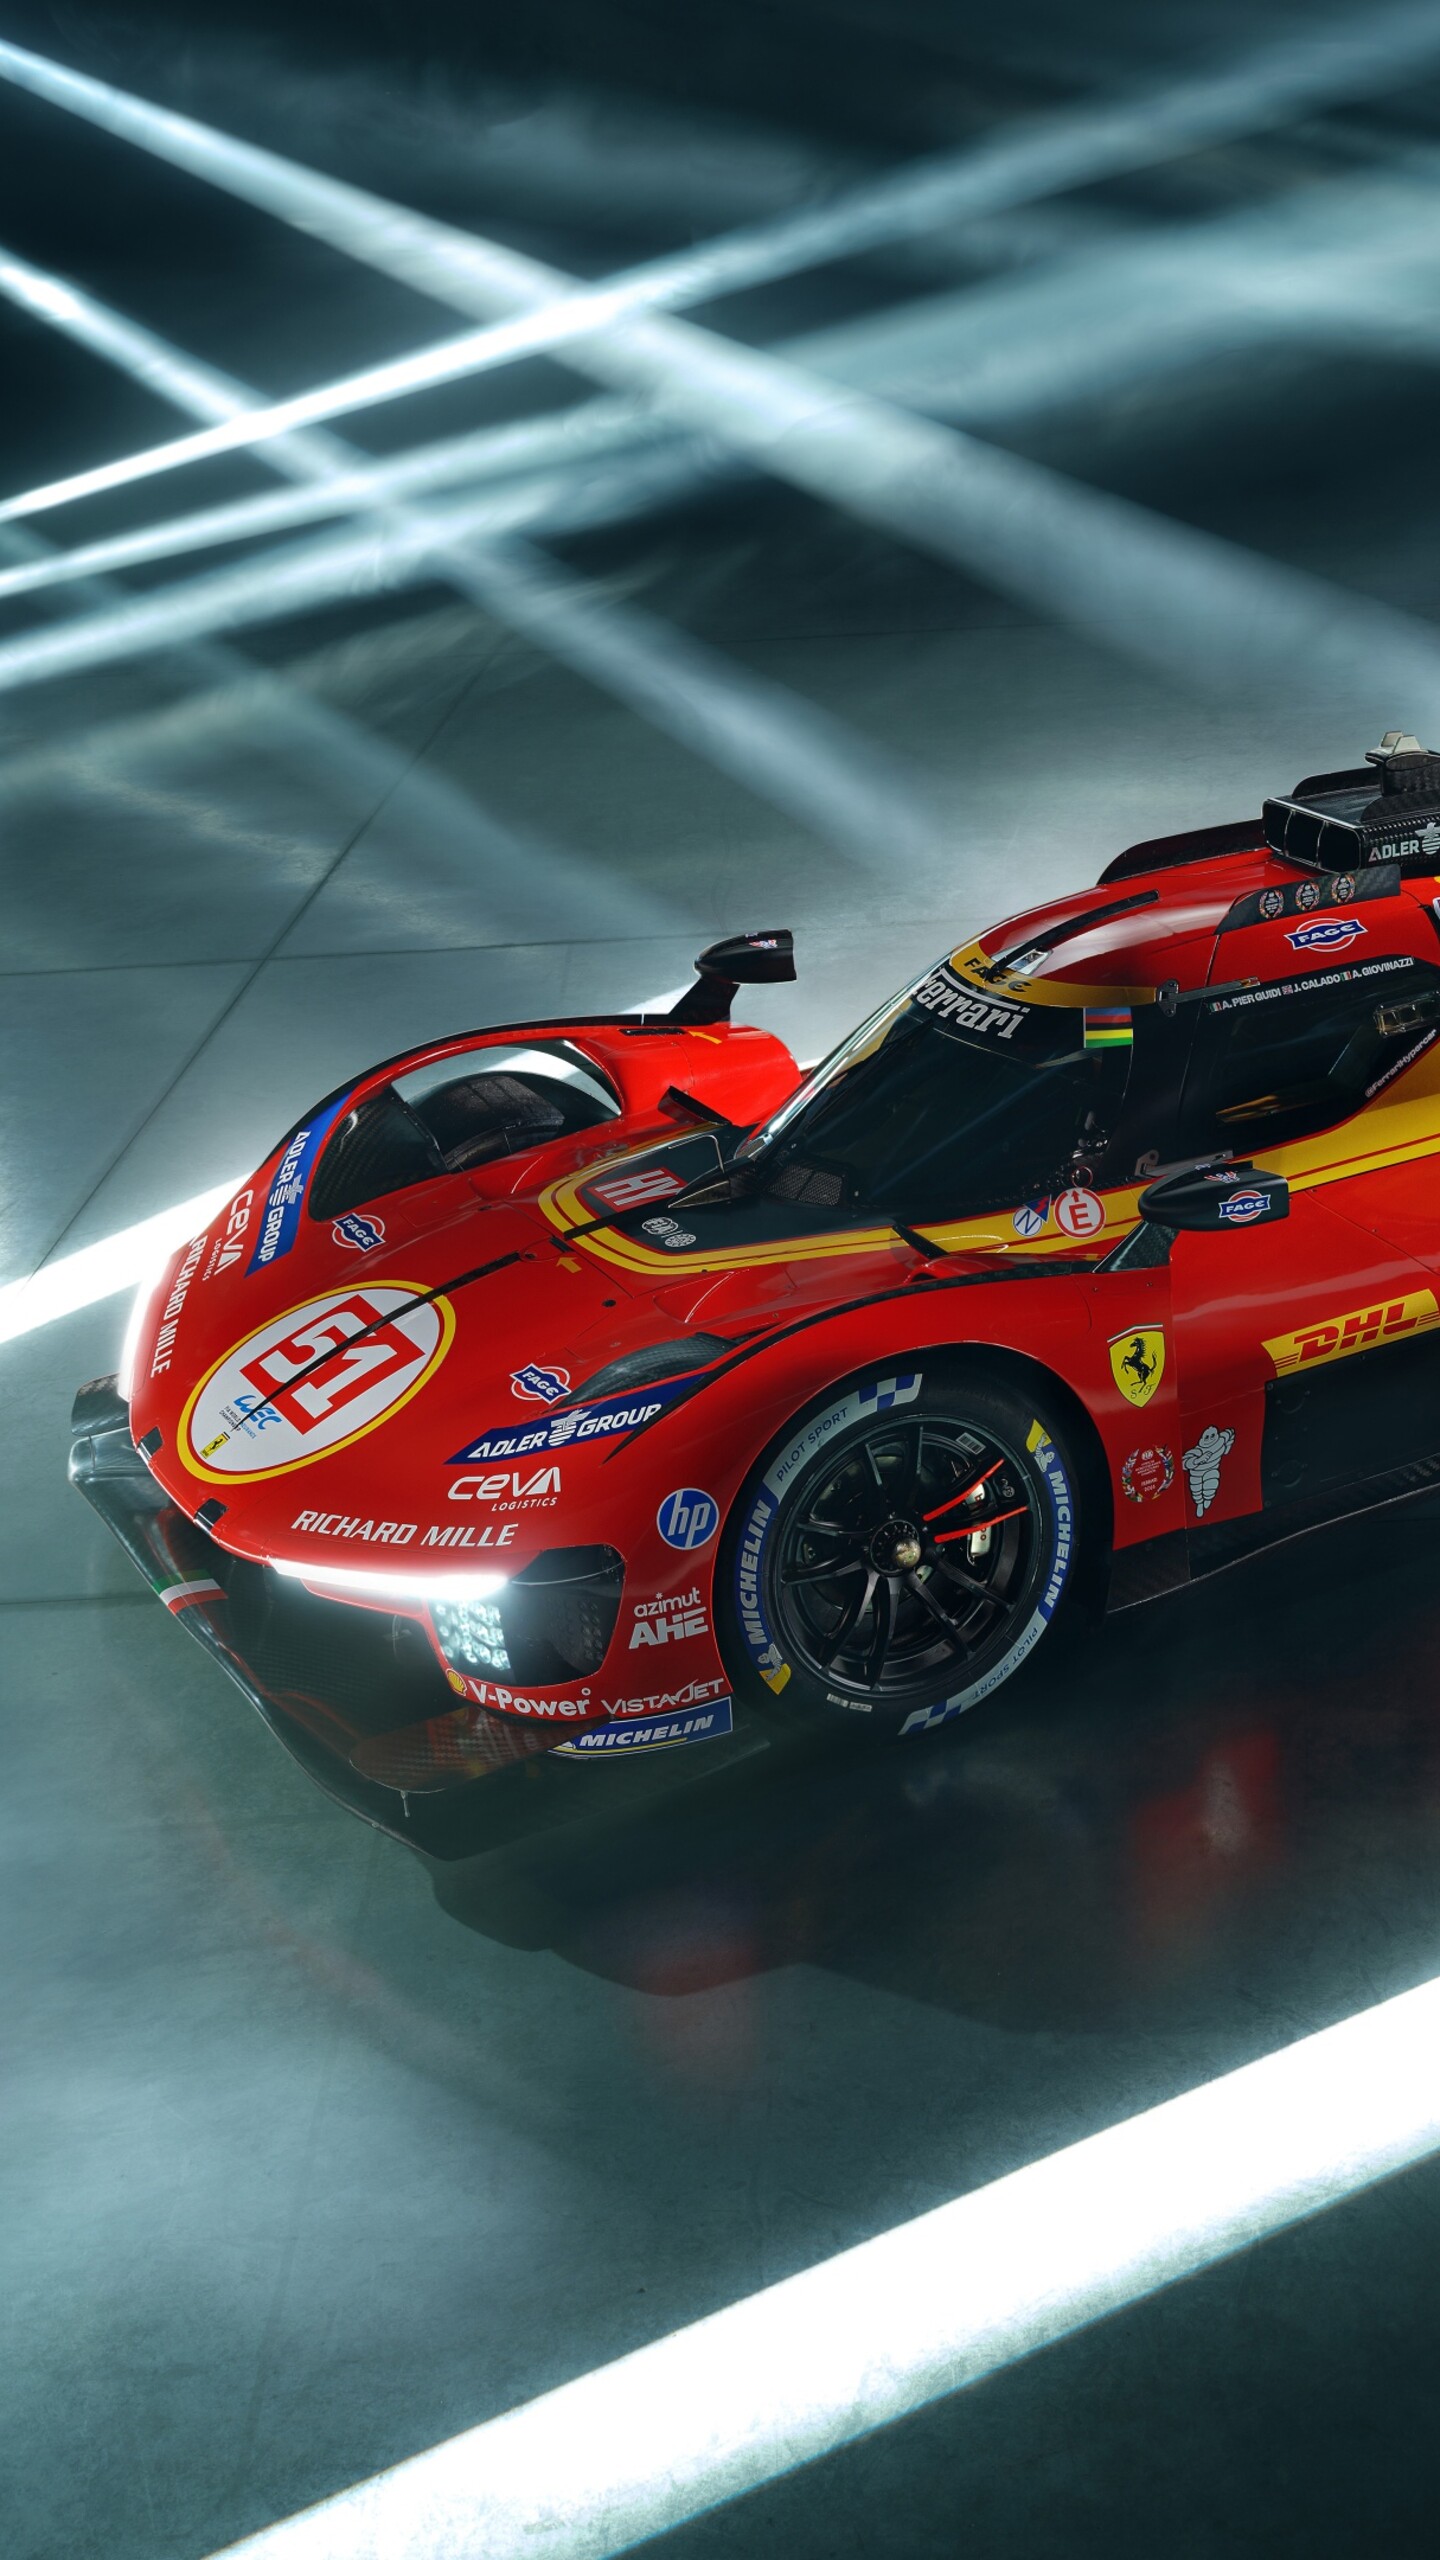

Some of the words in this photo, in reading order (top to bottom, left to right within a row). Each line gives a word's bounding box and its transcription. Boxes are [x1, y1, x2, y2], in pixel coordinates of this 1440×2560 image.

[1368, 839, 1420, 862] ADLER
[1298, 924, 1355, 943] FAGE
[1301, 974, 1341, 991] CALADO
[1362, 957, 1414, 977] GIOVINAZZI
[912, 967, 1031, 1039] Ferrari
[1232, 994, 1255, 1008] PIER
[1255, 988, 1281, 1002] GUIDI
[1365, 1029, 1437, 1098] @FerrariHypercar
[277, 1130, 311, 1186] ADLER
[1069, 1203, 1093, 1230] E
[1226, 1200, 1265, 1213] FAGE
[258, 1206, 284, 1263] GROUP
[343, 1219, 374, 1245] FAGE
[163, 1234, 208, 1321] RICHARD
[202, 1238, 222, 1282] LOGISTICS
[150, 1318, 180, 1378] MILLE
[1293, 1302, 1421, 1364] DHL
[258, 1311, 398, 1419] 51
[522, 1371, 559, 1397] FAGE
[234, 1395, 282, 1430] WEC
[467, 1431, 548, 1458] ADLER
[577, 1403, 662, 1437] GROUP
[776, 1441, 806, 1482] PILOT
[807, 1406, 848, 1444] SPORT
[491, 1497, 558, 1512] LOGISTICS
[667, 1489, 711, 1549] hp
[290, 1510, 418, 1544] RICHARD
[420, 1523, 519, 1547] MILLE
[1043, 1470, 1071, 1609] MICHELIN
[739, 1499, 772, 1645] MICHELIN
[634, 1587, 701, 1617] azimut
[1013, 1627, 1038, 1666] PILOT
[468, 1679, 590, 1716] V-Power
[972, 1662, 1010, 1701] SPORT
[579, 1714, 714, 1747] MICHELIN
